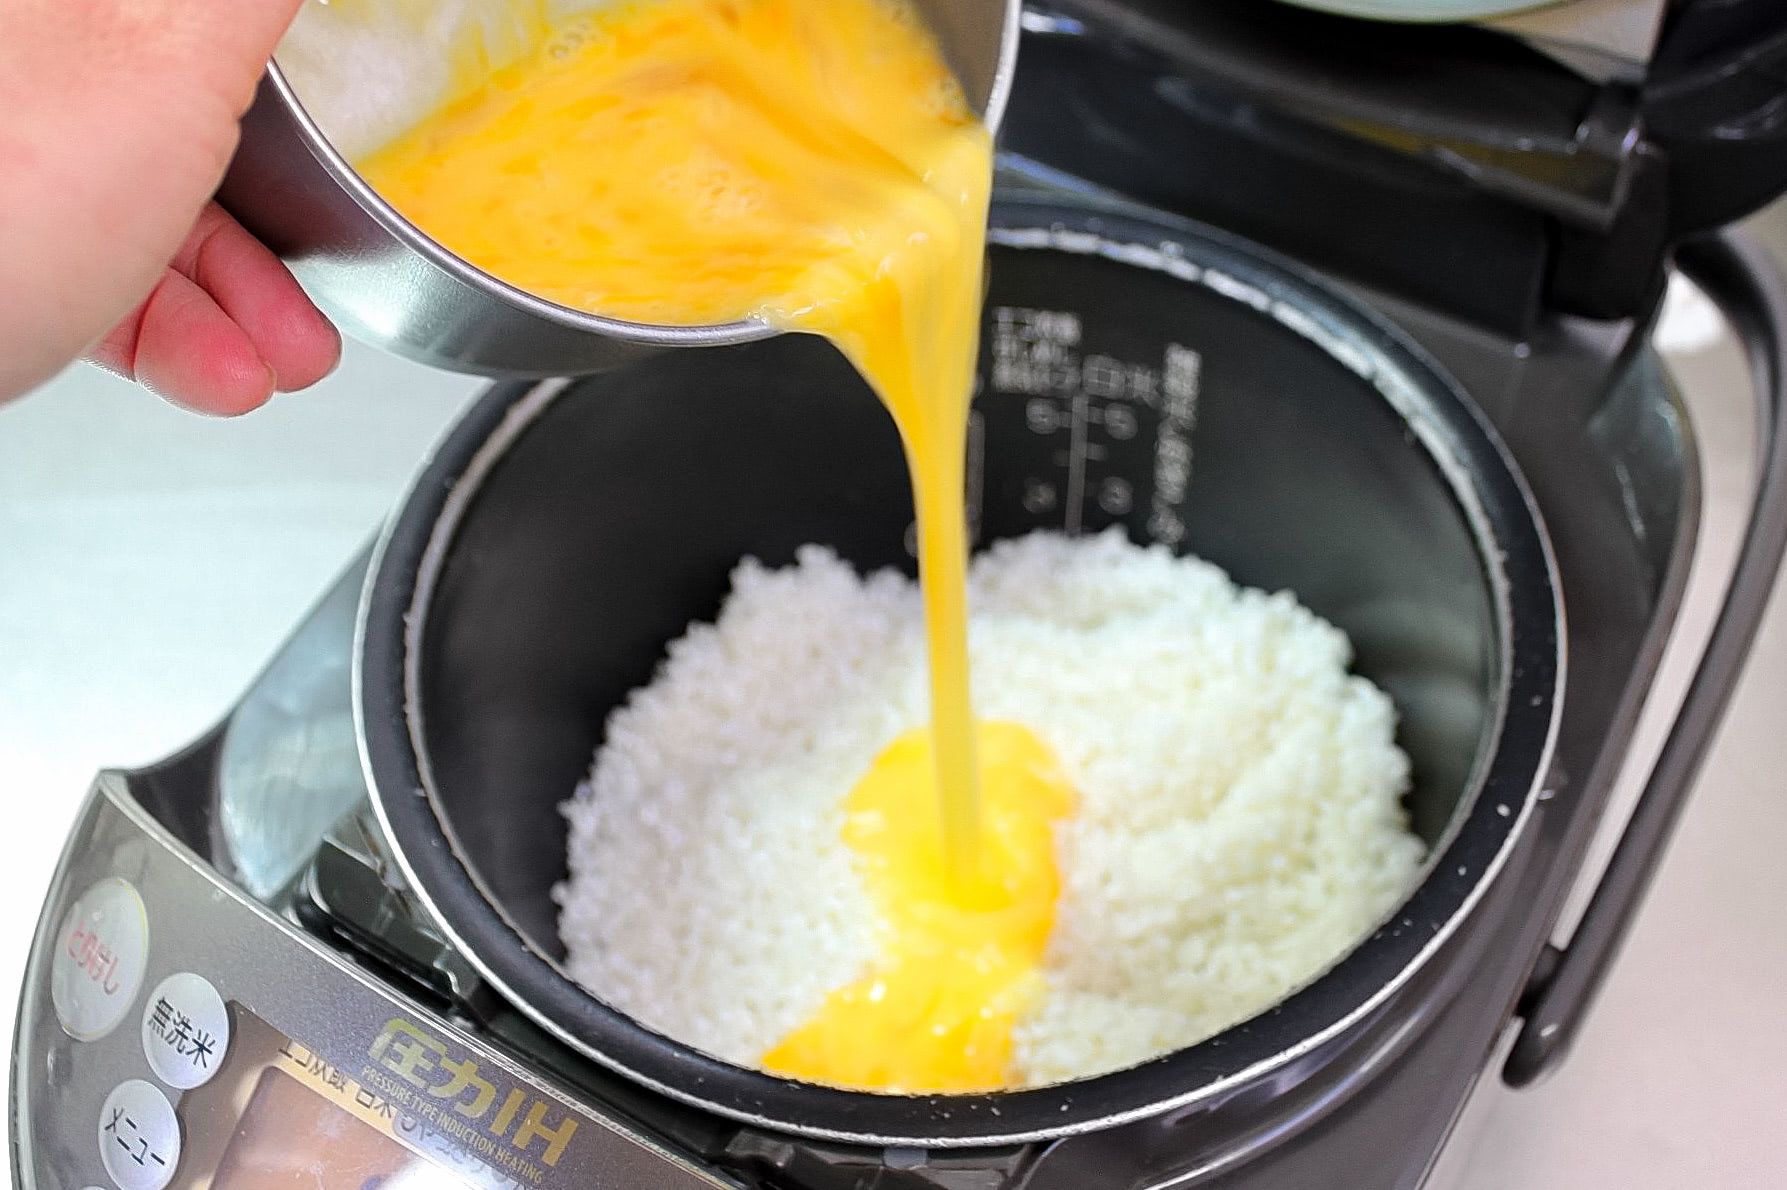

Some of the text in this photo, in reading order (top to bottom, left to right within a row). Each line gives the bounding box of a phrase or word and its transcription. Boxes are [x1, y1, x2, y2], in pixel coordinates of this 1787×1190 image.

[149, 996, 216, 1068] 無洗米
[104, 1107, 166, 1166] メニュー
[361, 1065, 412, 1105] PRESSURE
[410, 1094, 439, 1121] TYPE
[436, 1113, 497, 1157] INDUCTION
[494, 1148, 543, 1185] HEATING
[368, 1018, 579, 1166] 圧力IH
